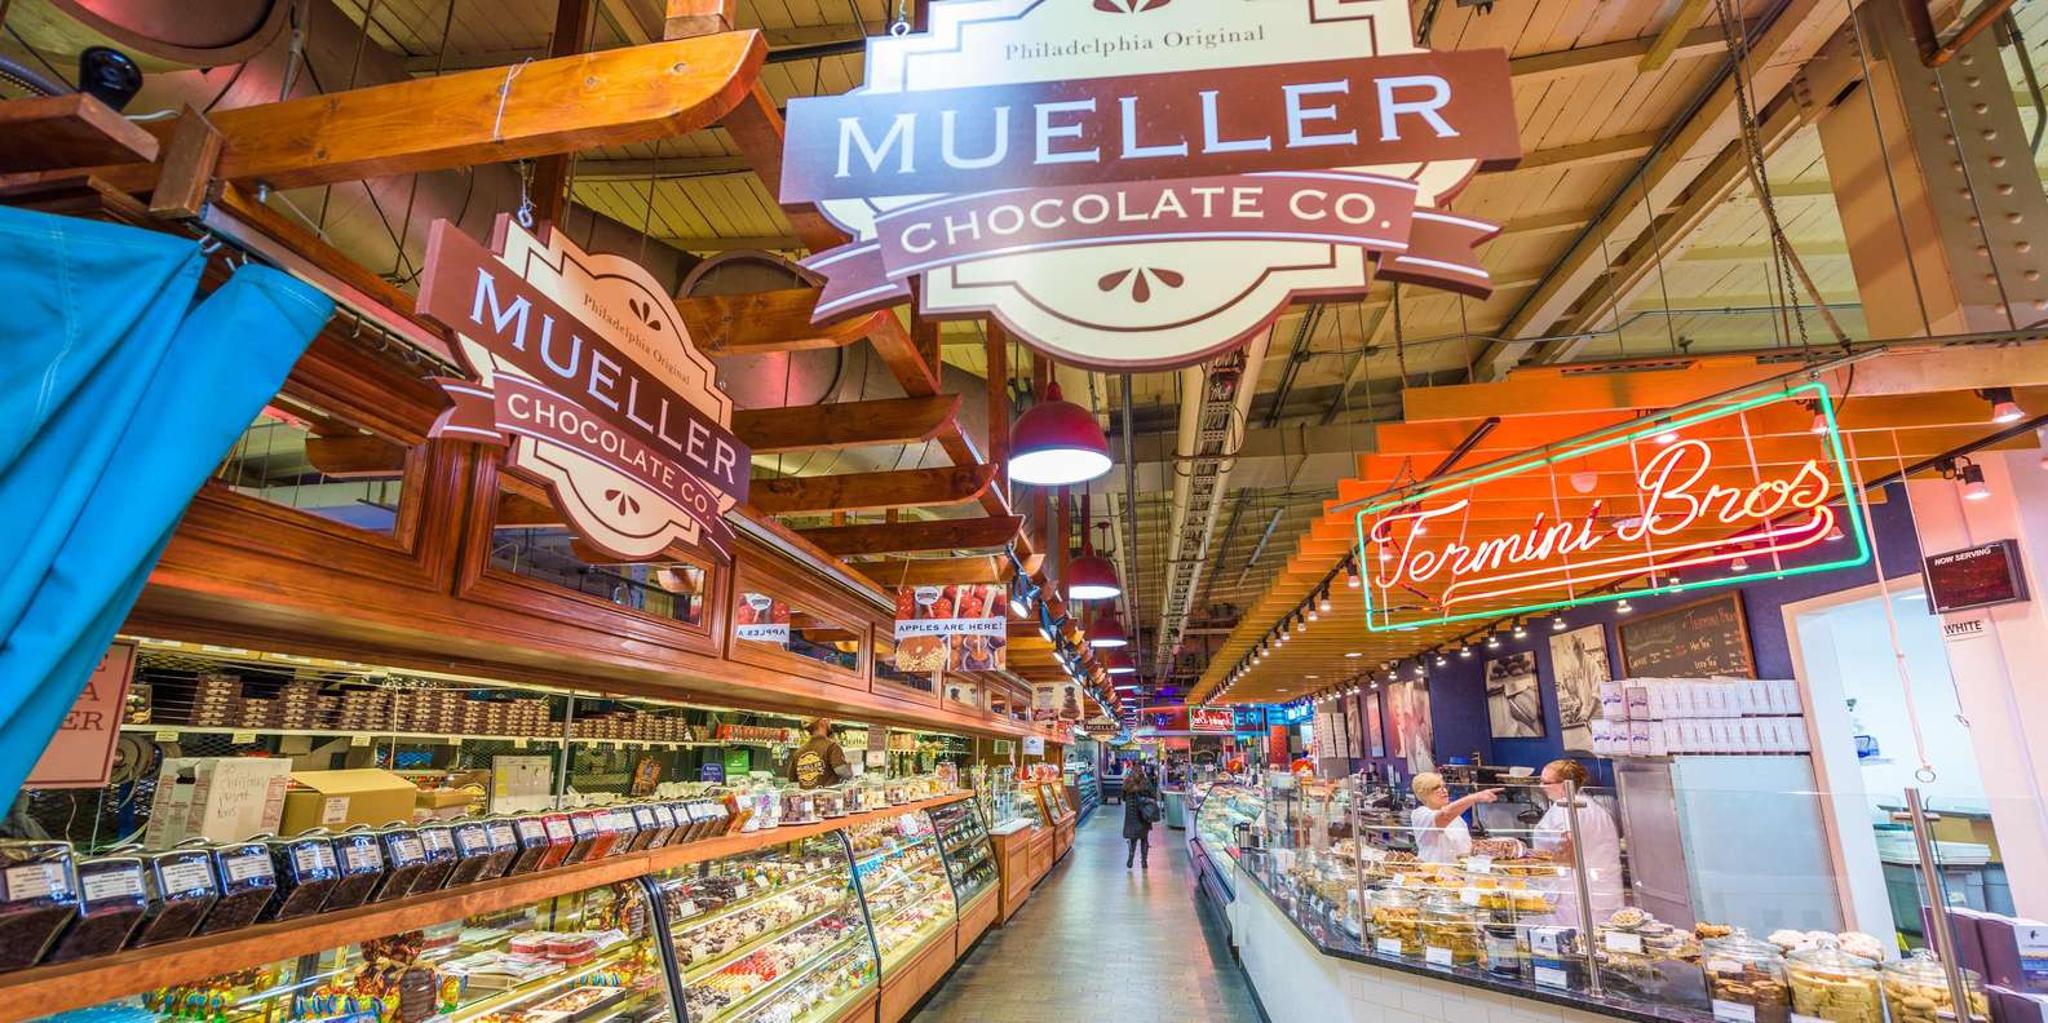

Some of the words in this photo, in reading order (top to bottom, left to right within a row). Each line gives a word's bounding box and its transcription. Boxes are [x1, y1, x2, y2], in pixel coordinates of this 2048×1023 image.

[1005, 34, 1154, 61] Philadelphia
[1163, 24, 1266, 50] Original
[834, 74, 1460, 179] MUELLER
[900, 186, 1265, 254] CHOCOLATE
[1289, 188, 1392, 230] CO.
[470, 267, 737, 485] MUELLER
[583, 294, 651, 354] Philadelphia
[652, 347, 691, 386] Original
[507, 393, 674, 489] CHOCOLATE
[682, 482, 712, 521] CO.
[1371, 500, 1604, 588] Termini
[1616, 439, 1830, 542] Bros
[1934, 556, 1954, 567] NOW
[1955, 548, 1992, 561] SERVING
[898, 623, 939, 632] APPLES
[944, 623, 965, 631] ARE
[969, 622, 1003, 631] HERE!
[1944, 620, 1982, 634] WHITE
